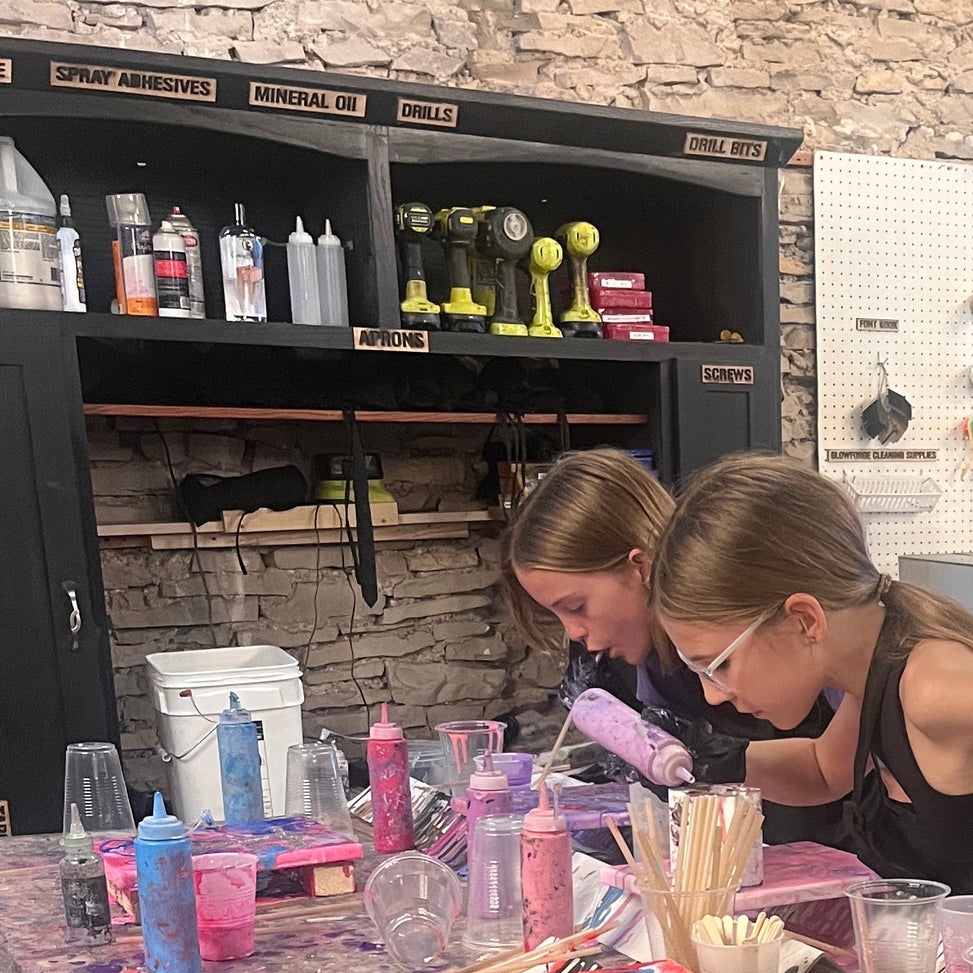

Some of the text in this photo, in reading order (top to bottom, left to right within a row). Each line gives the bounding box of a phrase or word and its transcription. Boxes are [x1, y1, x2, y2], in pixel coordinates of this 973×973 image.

[56, 66, 211, 97] SPRAY ADHESIVES
[254, 86, 329, 109] MINERAL
[401, 103, 453, 122] DRILLS
[688, 137, 762, 158] DRILL BITS
[359, 330, 425, 349] APRONS
[704, 368, 752, 382] SCREWS
[873, 451, 904, 460] CLEANING
[906, 451, 937, 460] SUPPLIES
